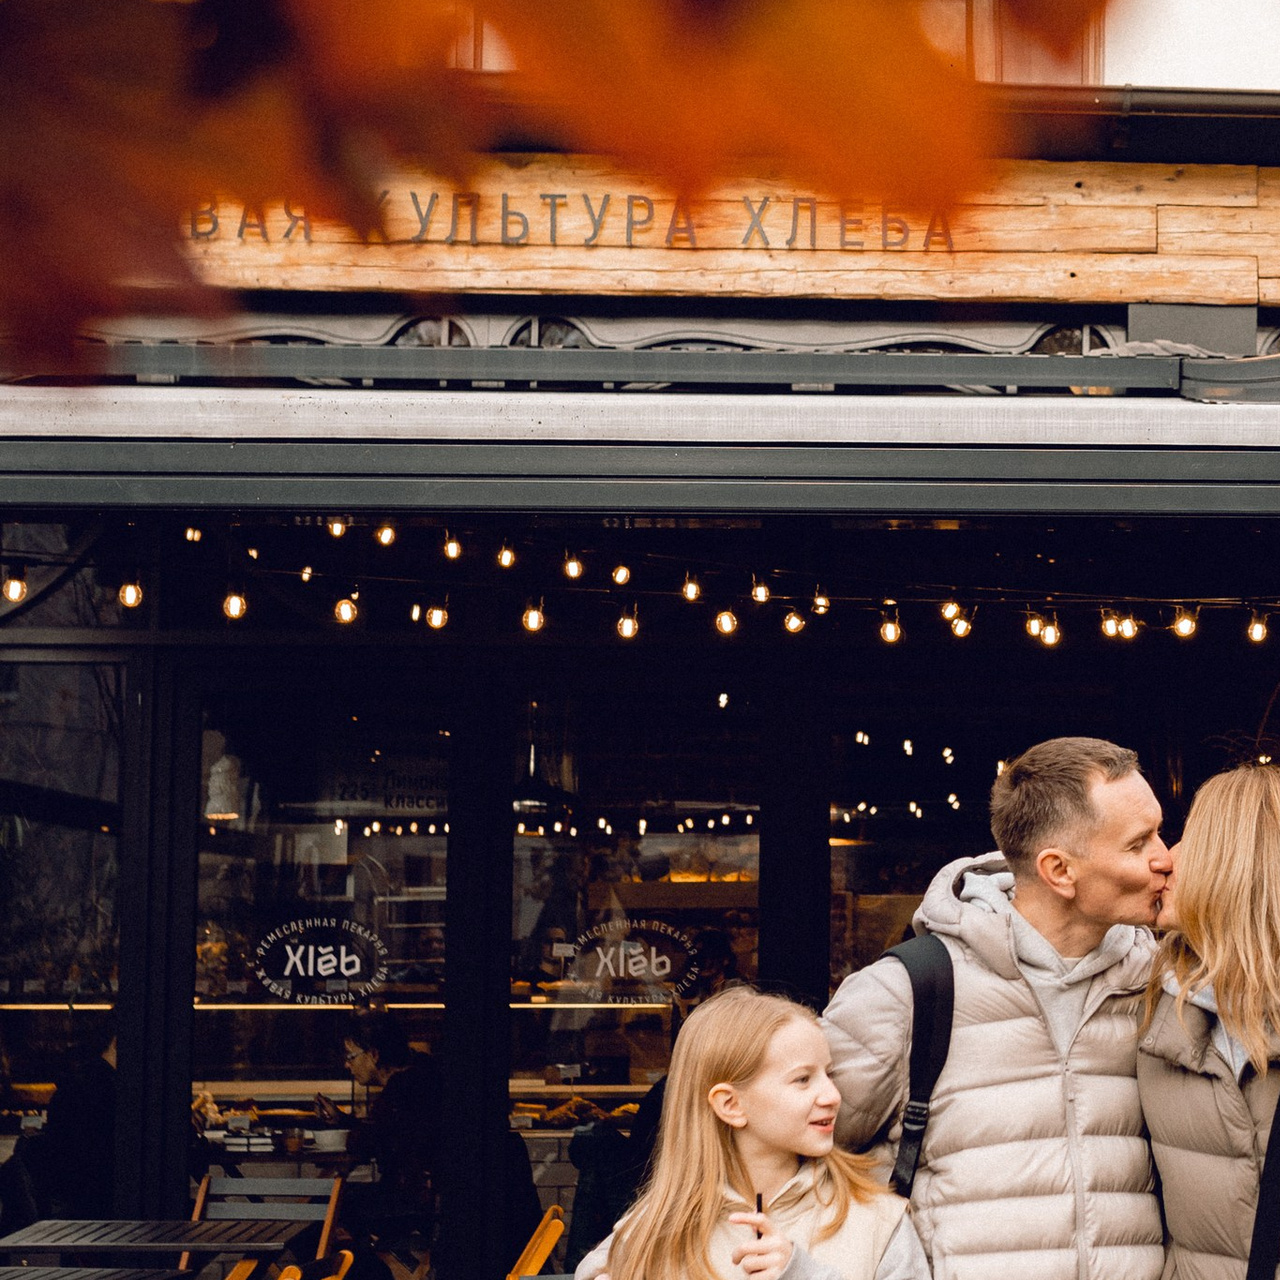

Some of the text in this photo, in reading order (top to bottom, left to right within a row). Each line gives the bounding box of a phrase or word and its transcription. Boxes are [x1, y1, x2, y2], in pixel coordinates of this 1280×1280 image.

[742, 195, 956, 251] ХЛЕБА
[256, 917, 389, 957] РЕМЕСЛЕННАЯ ПЕКАРНЯ
[571, 918, 697, 955] ЕМЕСЛЕННАЯ ПЕКАРНЯ
[255, 966, 389, 1005] ЖИВАЯ КУЛЬТУРА ХЛЕБА
